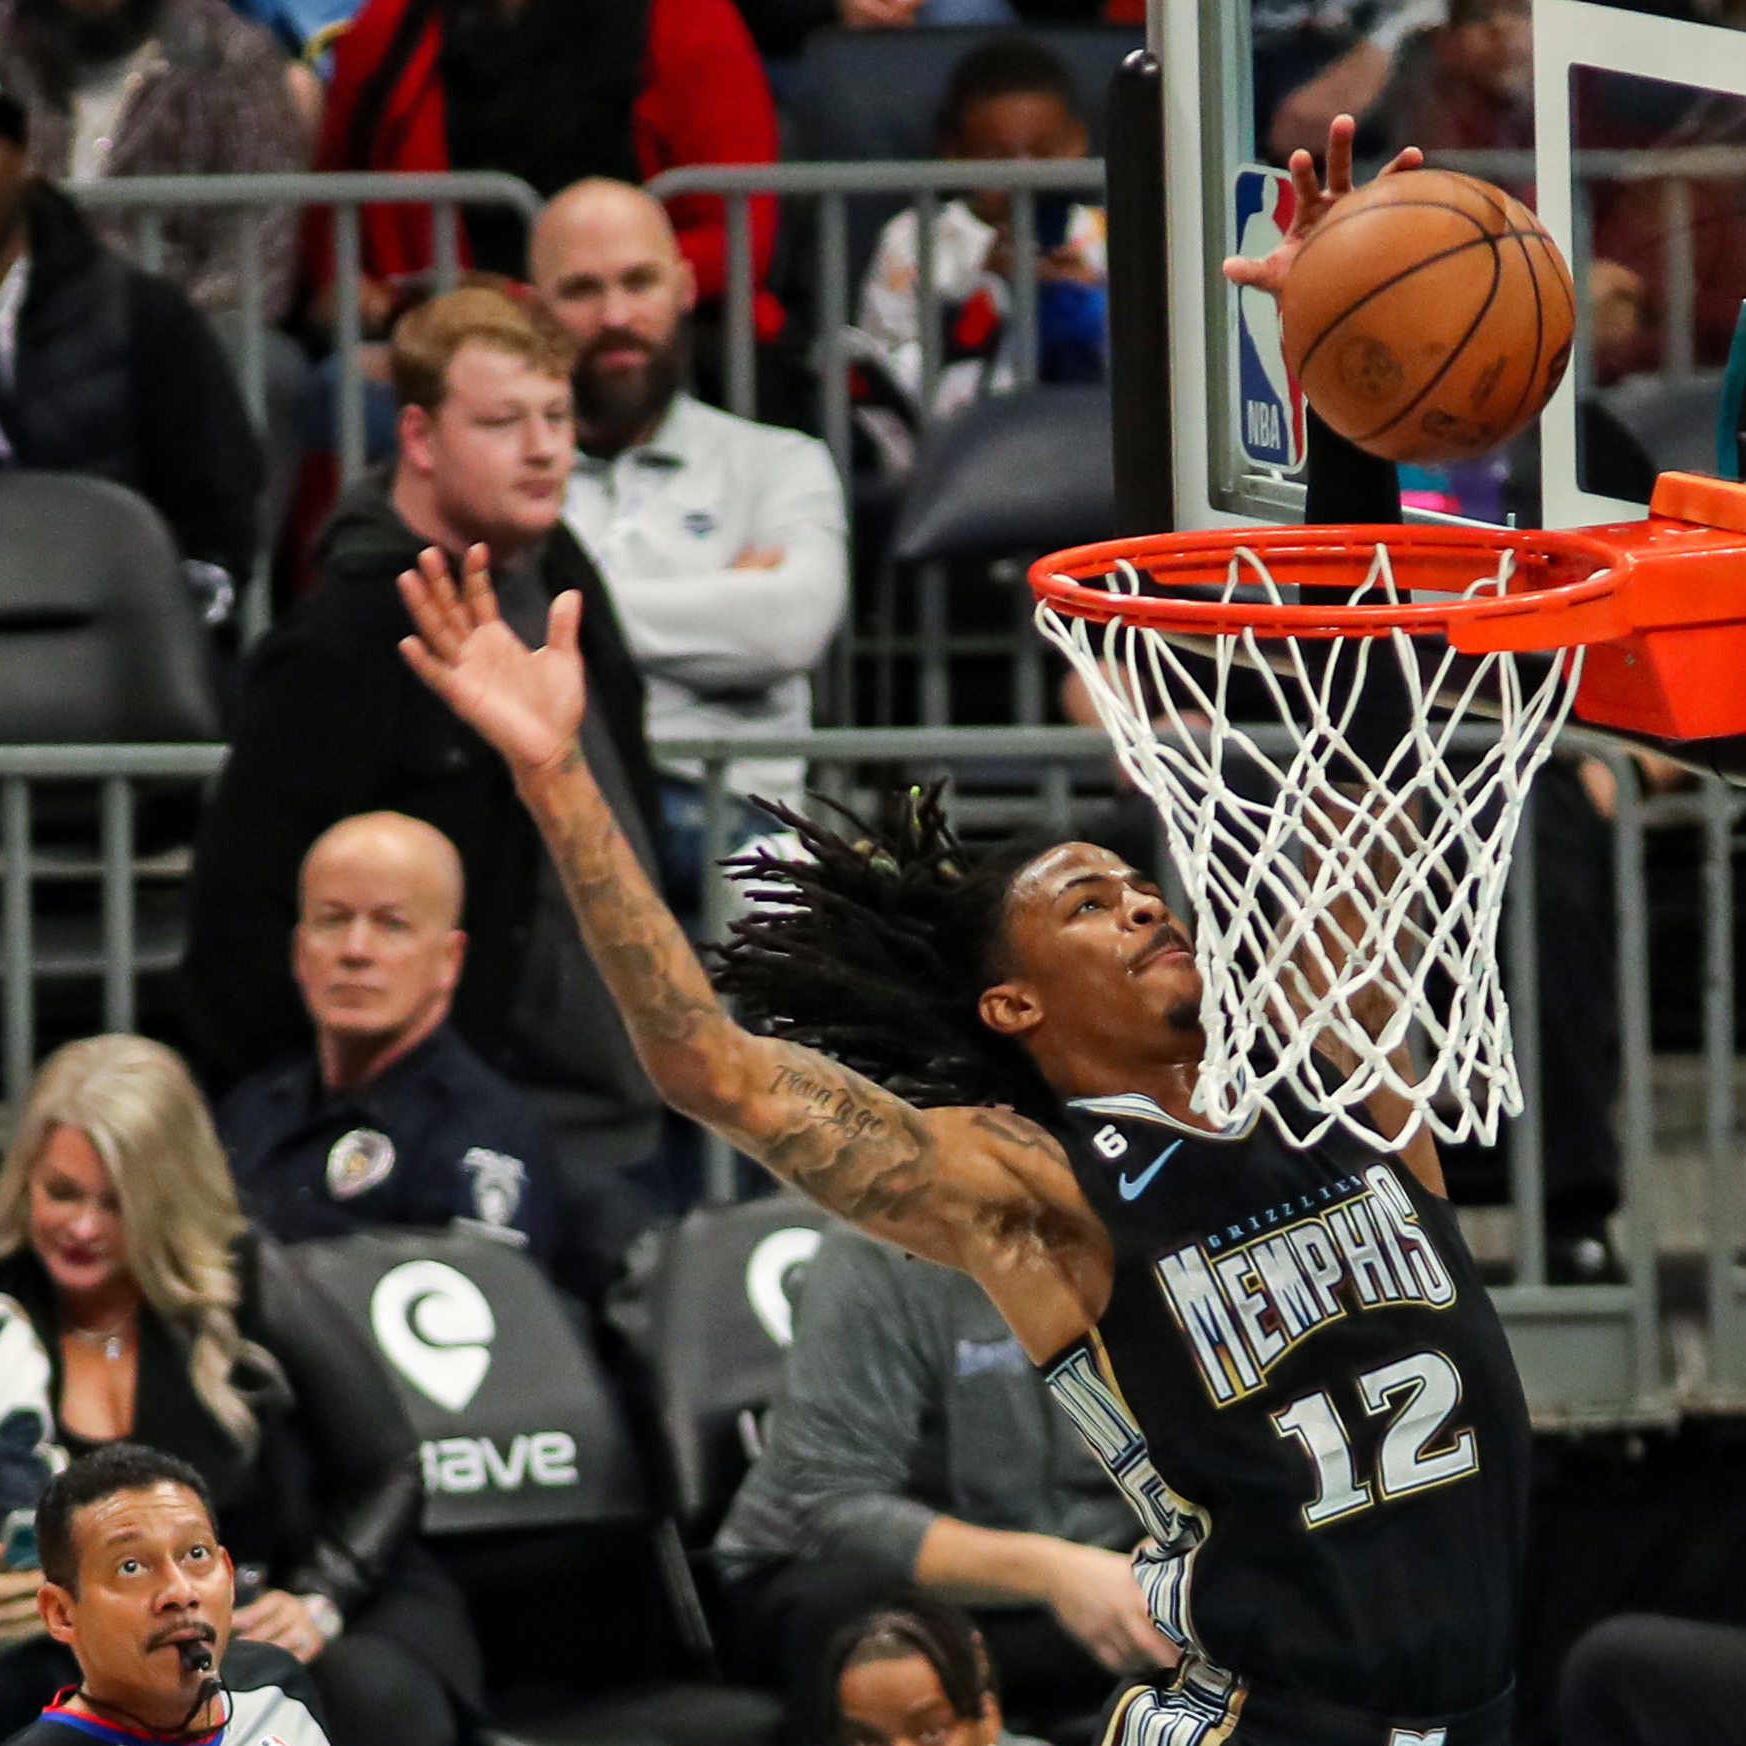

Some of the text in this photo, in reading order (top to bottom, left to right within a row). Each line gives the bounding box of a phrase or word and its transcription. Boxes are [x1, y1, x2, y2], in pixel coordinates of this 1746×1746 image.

[1245, 399, 1283, 452] NBA
[1092, 1124, 1129, 1159] 6
[1156, 1163, 1456, 1407] MEMPHIS
[421, 1430, 579, 1492] ave
[1271, 1350, 1479, 1530] 12
